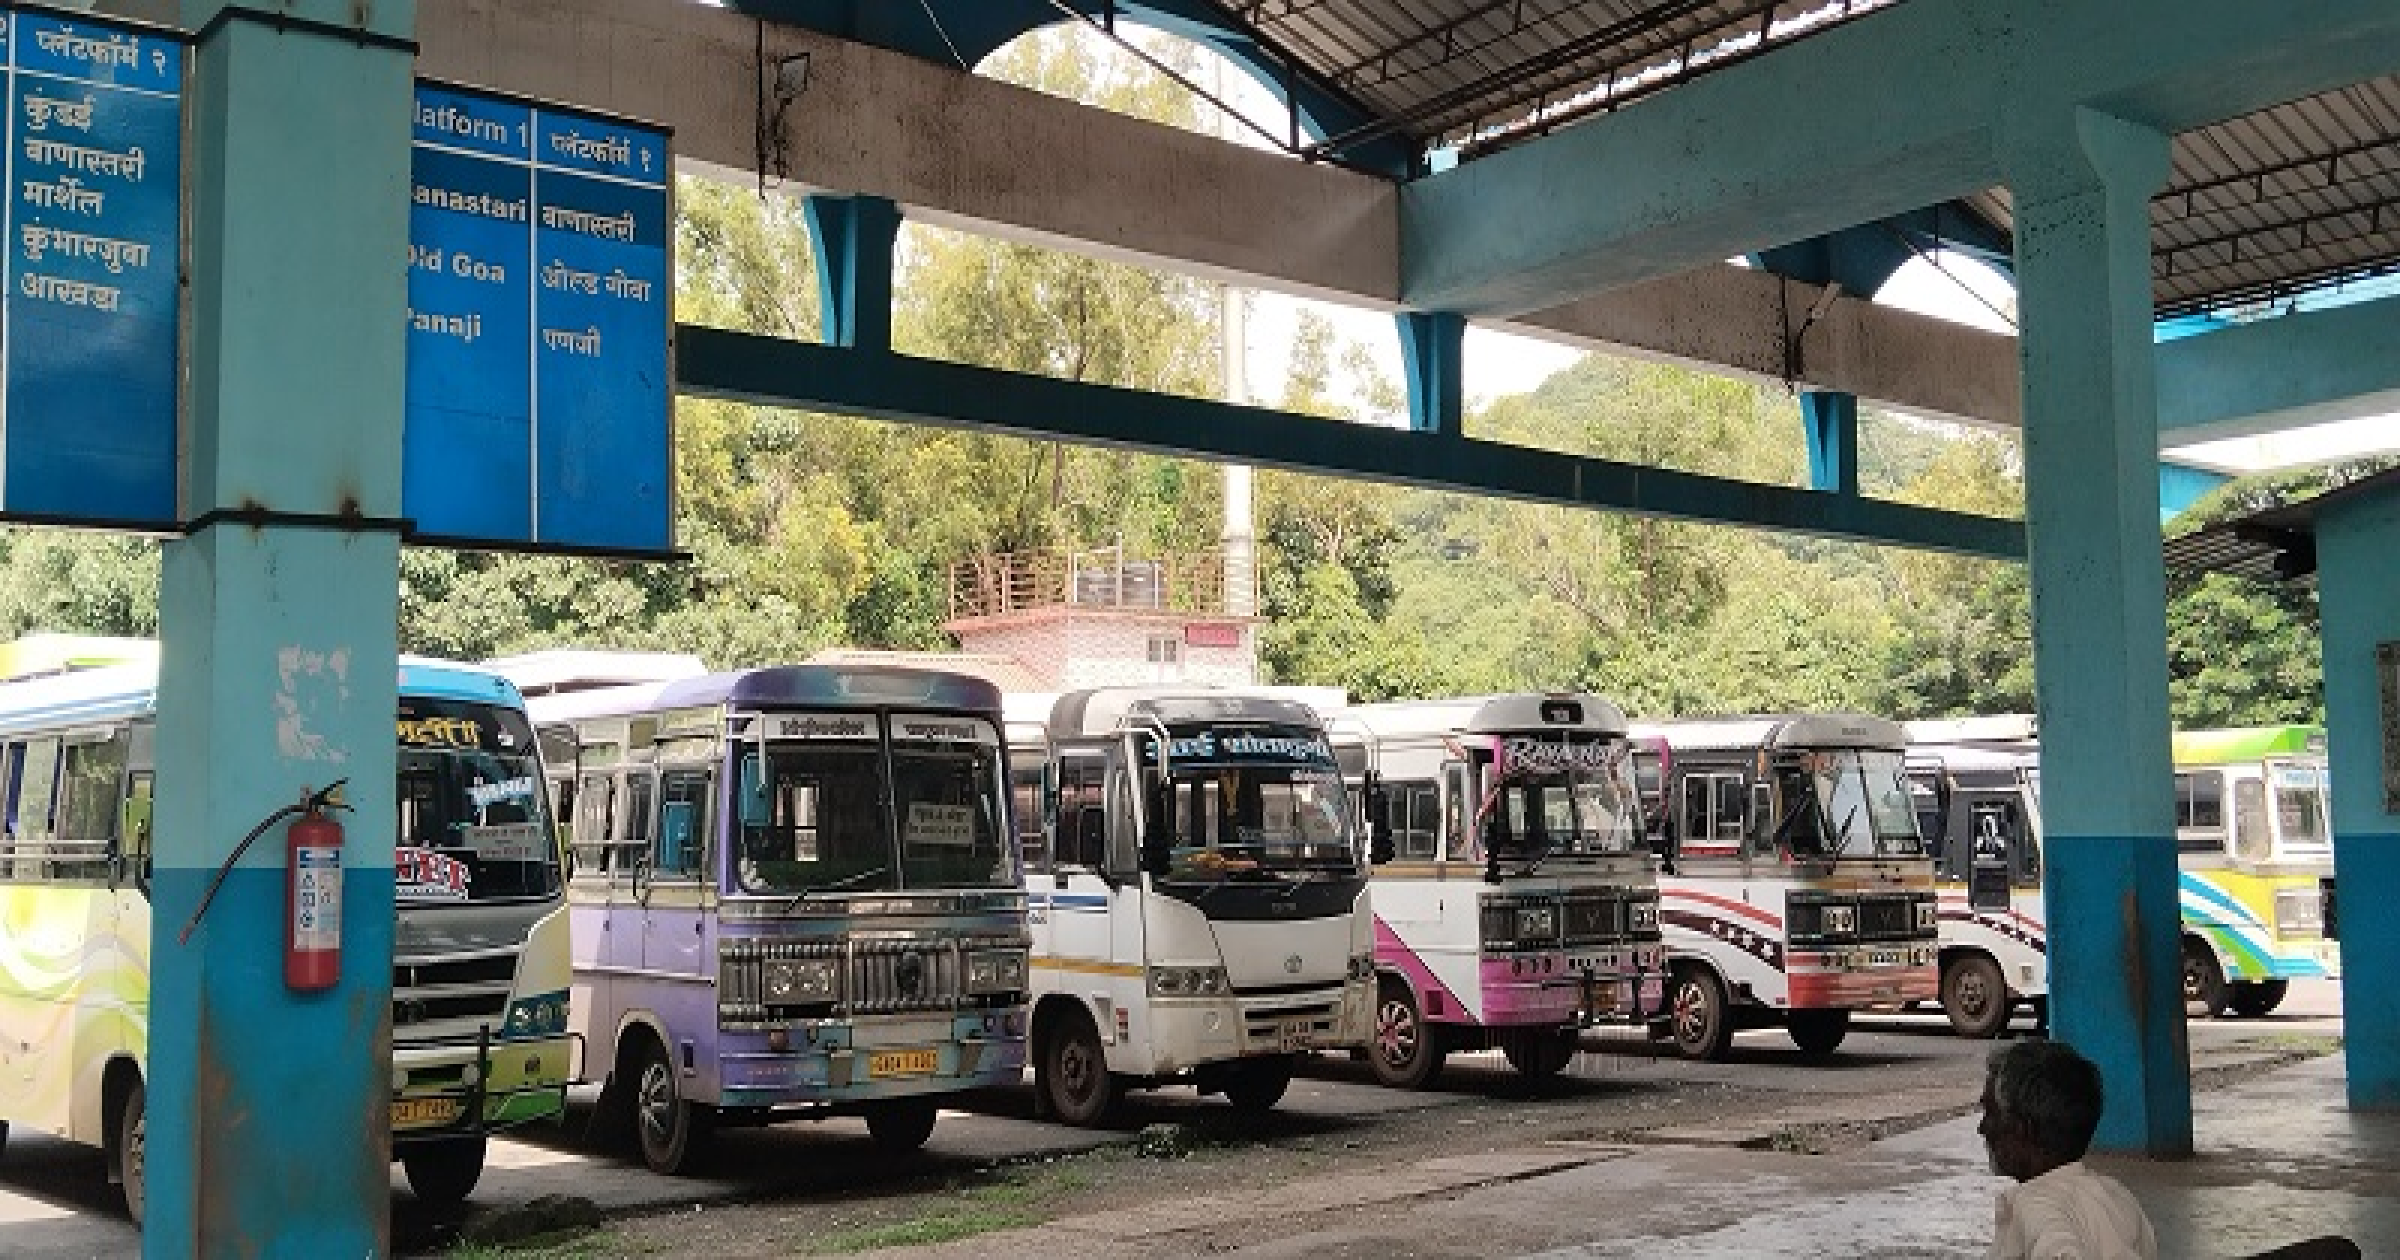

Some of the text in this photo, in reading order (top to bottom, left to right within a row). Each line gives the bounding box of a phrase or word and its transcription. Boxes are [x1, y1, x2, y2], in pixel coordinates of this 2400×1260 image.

[152, 49, 166, 77] २
[413, 99, 529, 147] latform 1
[641, 146, 653, 173] १
[412, 185, 526, 221] anastari
[452, 252, 505, 284] Goa
[407, 307, 481, 343] anaji
[542, 323, 601, 358] पणजी
